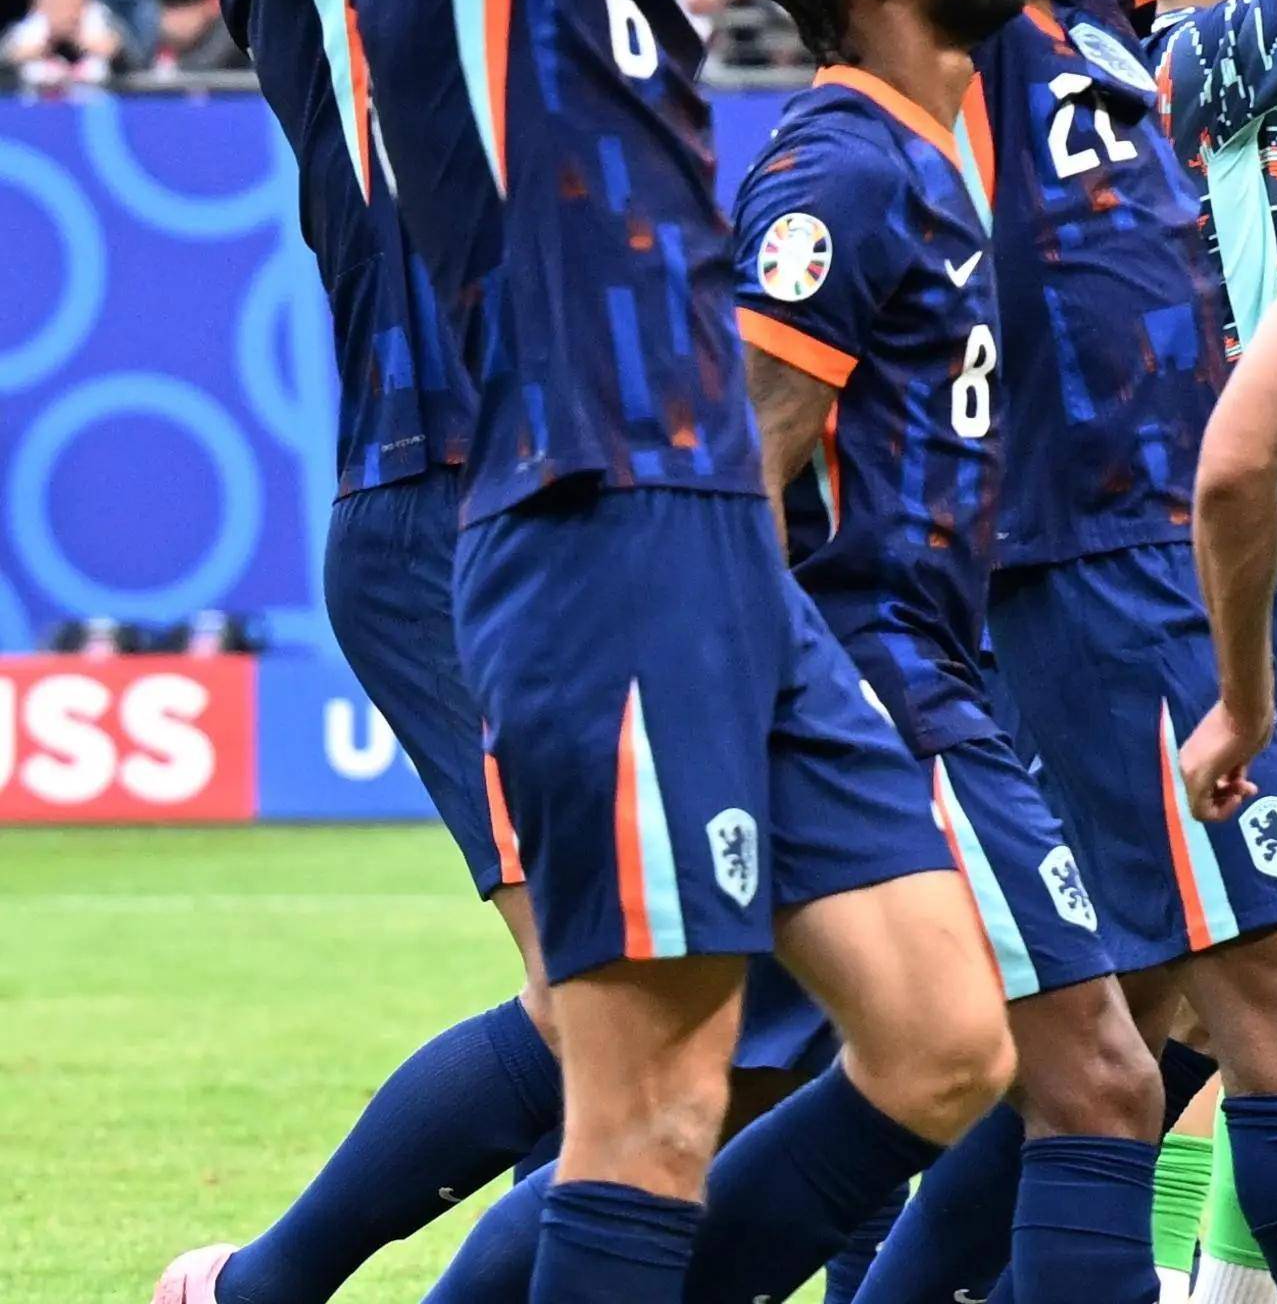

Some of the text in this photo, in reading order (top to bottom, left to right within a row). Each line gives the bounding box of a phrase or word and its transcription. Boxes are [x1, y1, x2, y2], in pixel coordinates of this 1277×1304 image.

[951, 324, 997, 438] 8
[0, 674, 215, 805] SS
[324, 697, 418, 781] U
